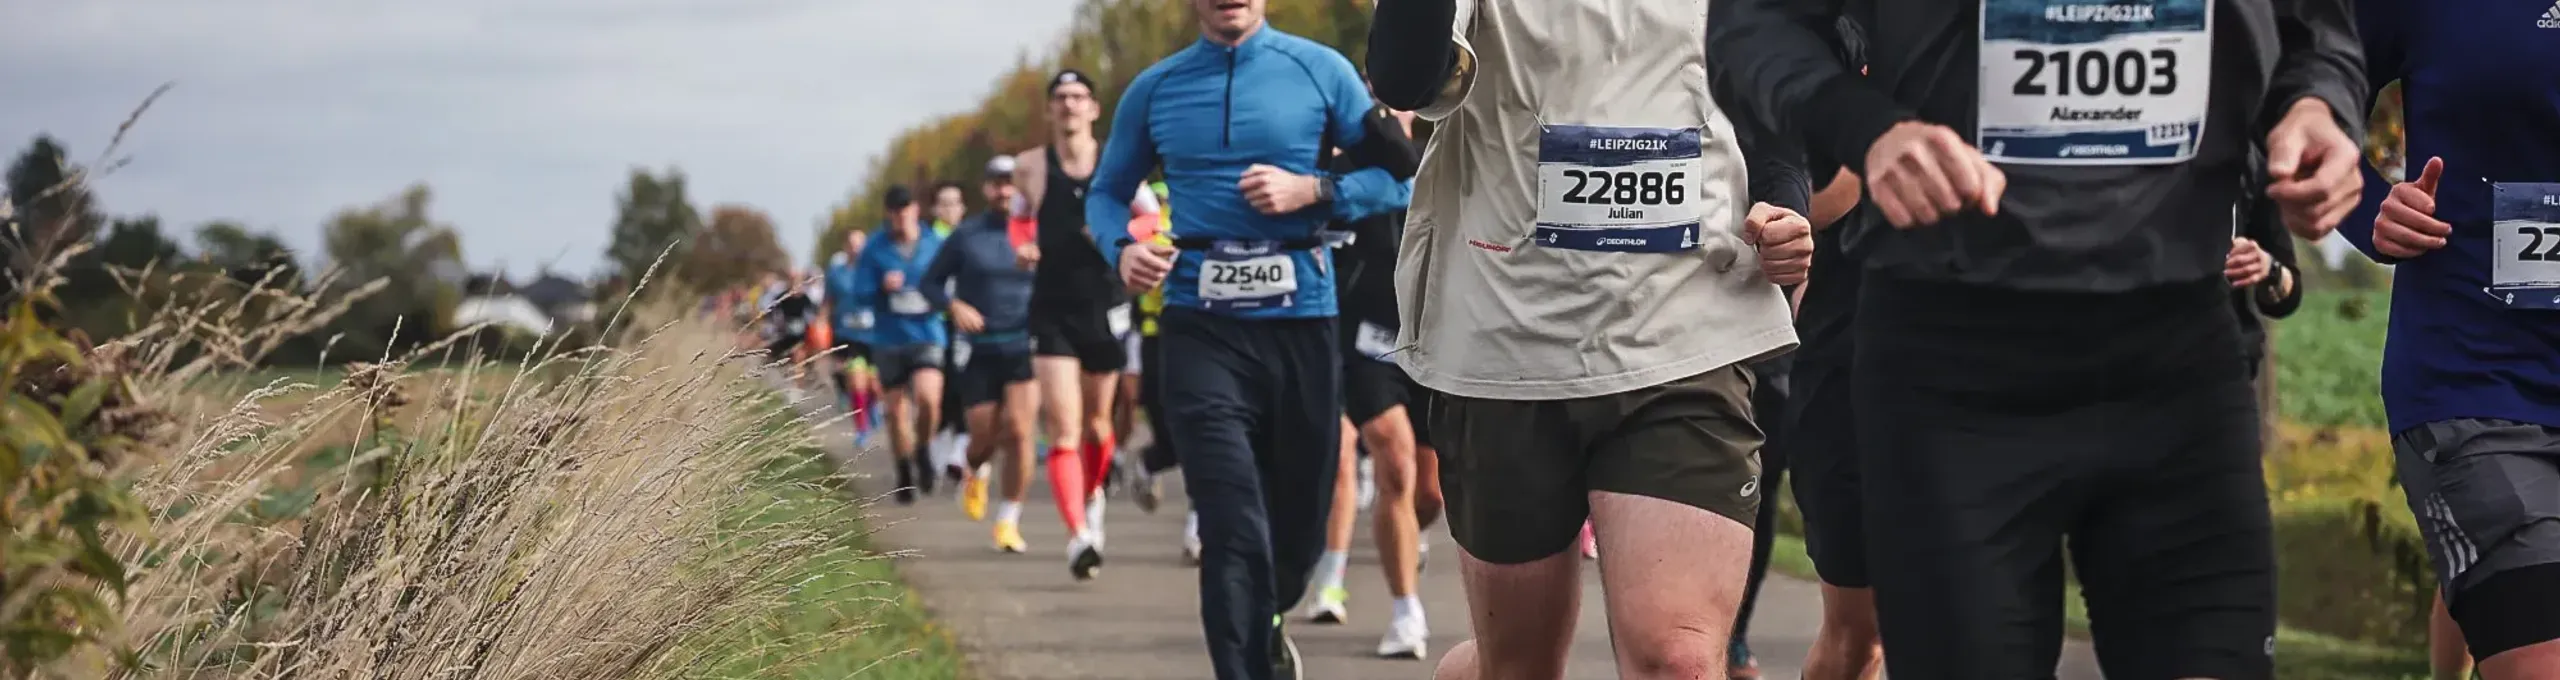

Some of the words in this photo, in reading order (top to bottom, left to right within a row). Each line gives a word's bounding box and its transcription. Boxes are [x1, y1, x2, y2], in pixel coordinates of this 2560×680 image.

[2045, 3, 2154, 22] #LEIPZIG21K
[2012, 49, 2177, 96] 21003
[2050, 106, 2142, 121] Alexander
[1589, 138, 1668, 151] #LEIPZIG21K
[1562, 169, 1685, 205] 22886
[1607, 207, 1644, 219] Julian
[1606, 237, 1647, 246] DECATHLON
[1211, 264, 1282, 284] 22540
